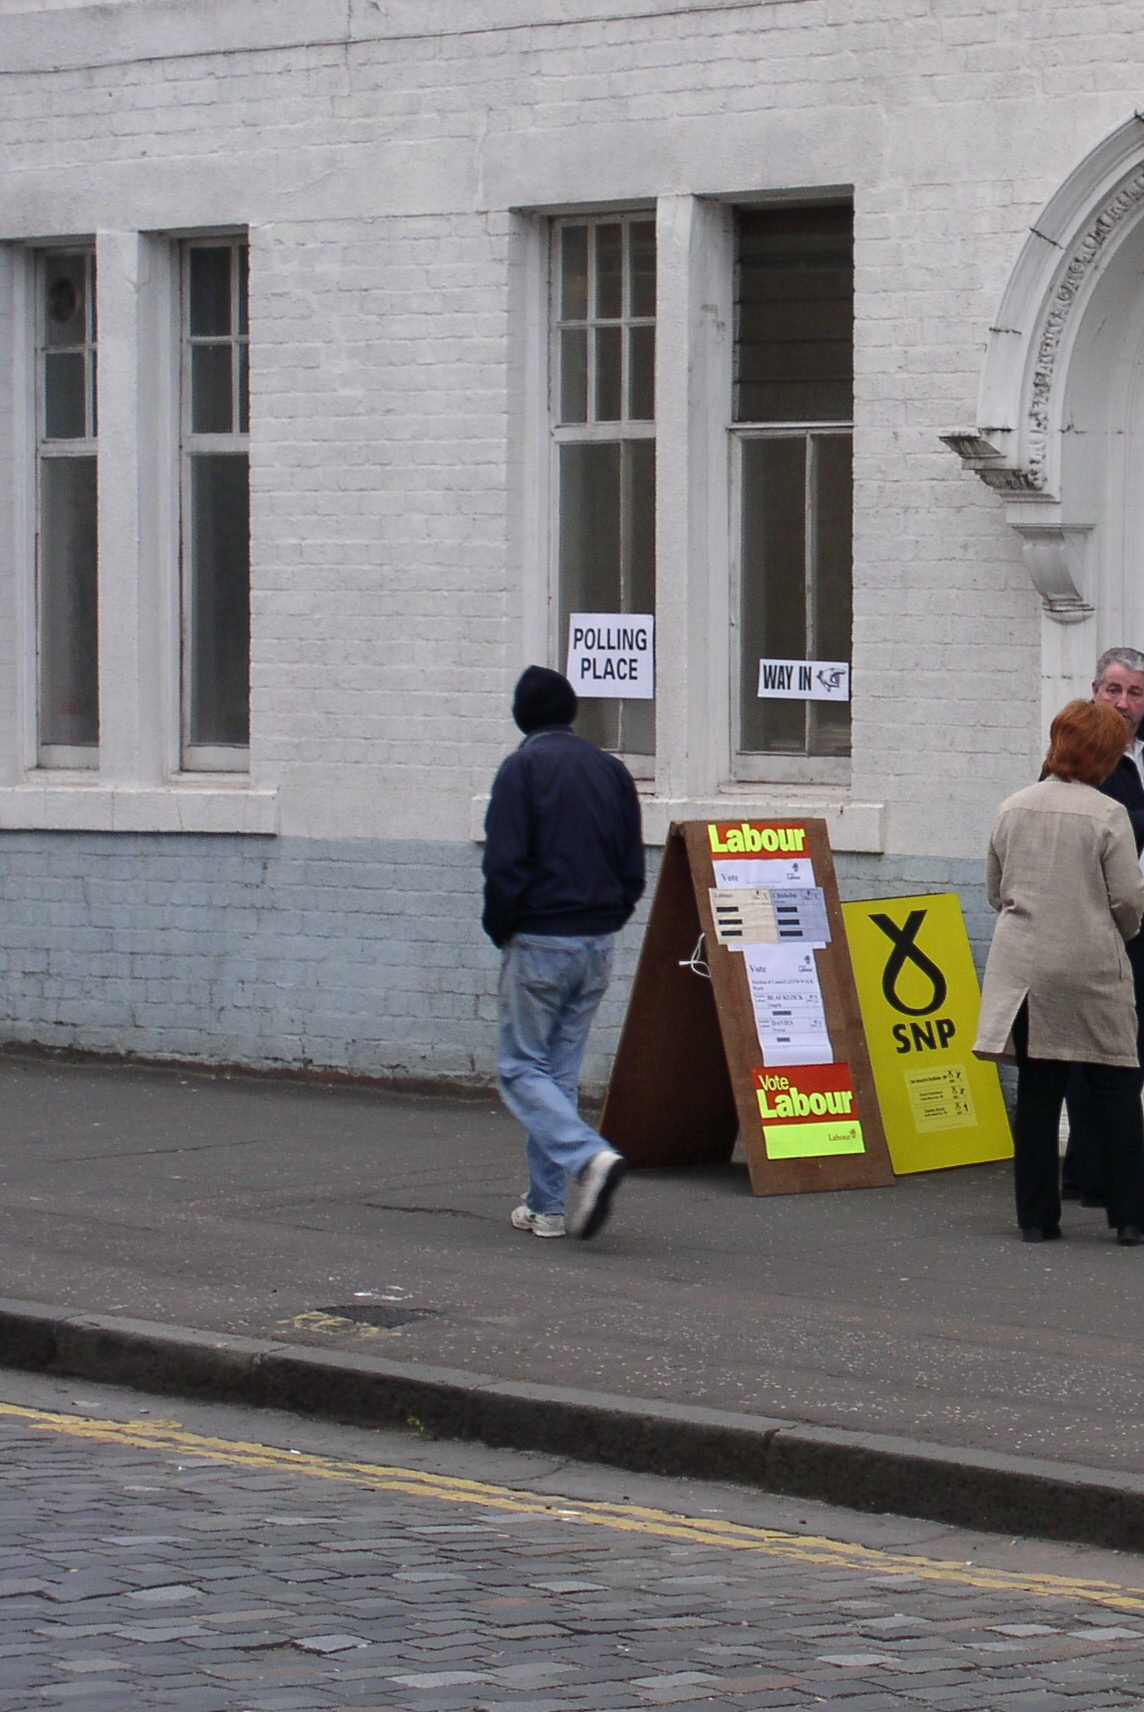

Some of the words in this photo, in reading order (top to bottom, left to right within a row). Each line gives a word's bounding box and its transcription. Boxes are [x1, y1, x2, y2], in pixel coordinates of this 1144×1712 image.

[573, 628, 647, 650] POLLING
[580, 657, 638, 680] PLACE
[762, 664, 793, 690] WAY
[799, 665, 812, 691] IN
[707, 823, 805, 853] Labour
[892, 1018, 956, 1054] SNP
[758, 1075, 789, 1091] Vote
[756, 1087, 853, 1119] Labour
